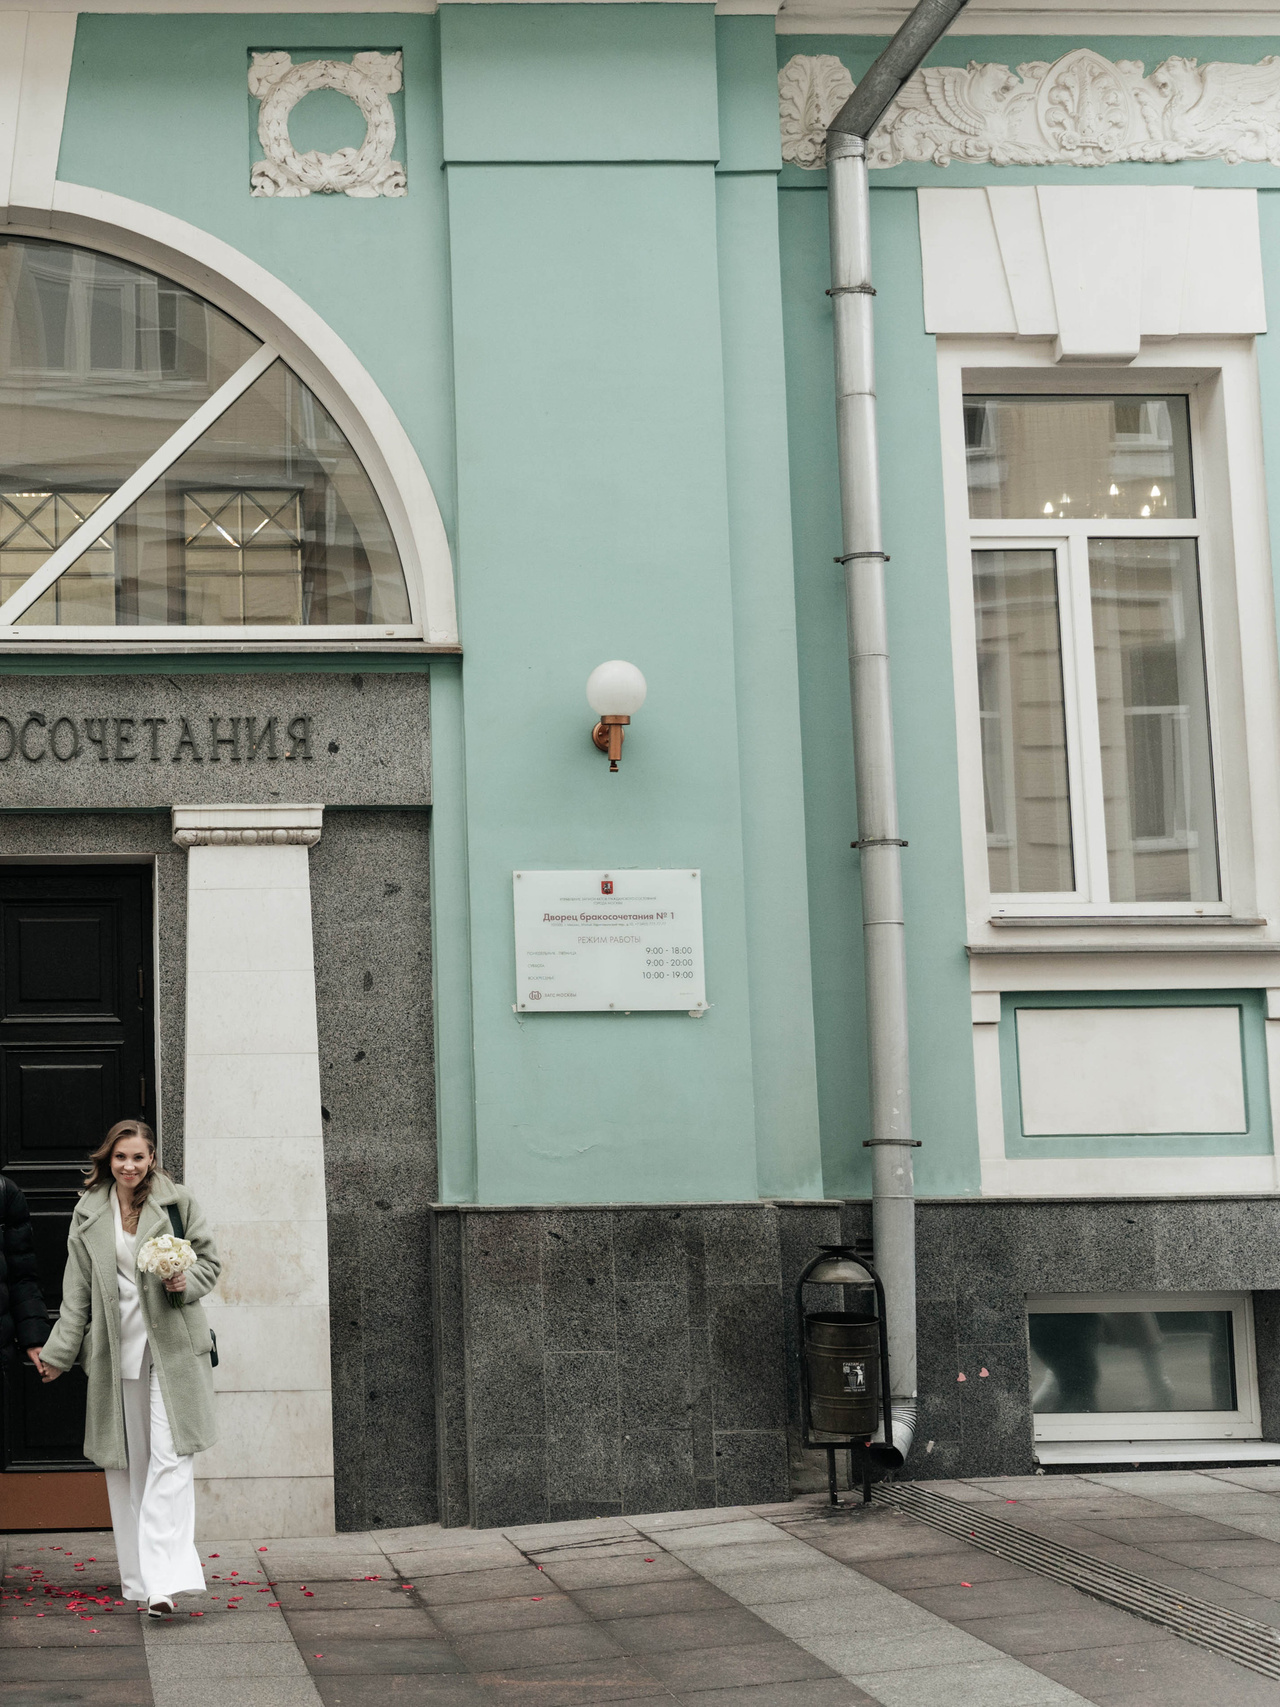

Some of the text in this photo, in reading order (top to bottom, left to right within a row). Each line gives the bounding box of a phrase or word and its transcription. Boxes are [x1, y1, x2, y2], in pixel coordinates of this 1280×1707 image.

[542, 912, 579, 923] Дворец
[579, 911, 654, 923] бракосочетания
[670, 911, 675, 920] 1
[577, 935, 641, 944] РЕЖИМ РАБОТЫ
[645, 946, 664, 955] 9:00
[671, 946, 693, 955] 18:00
[646, 958, 665, 967] 9:00
[670, 958, 693, 967] 20:00
[642, 971, 665, 980] 10:00
[672, 970, 694, 979] 19:00
